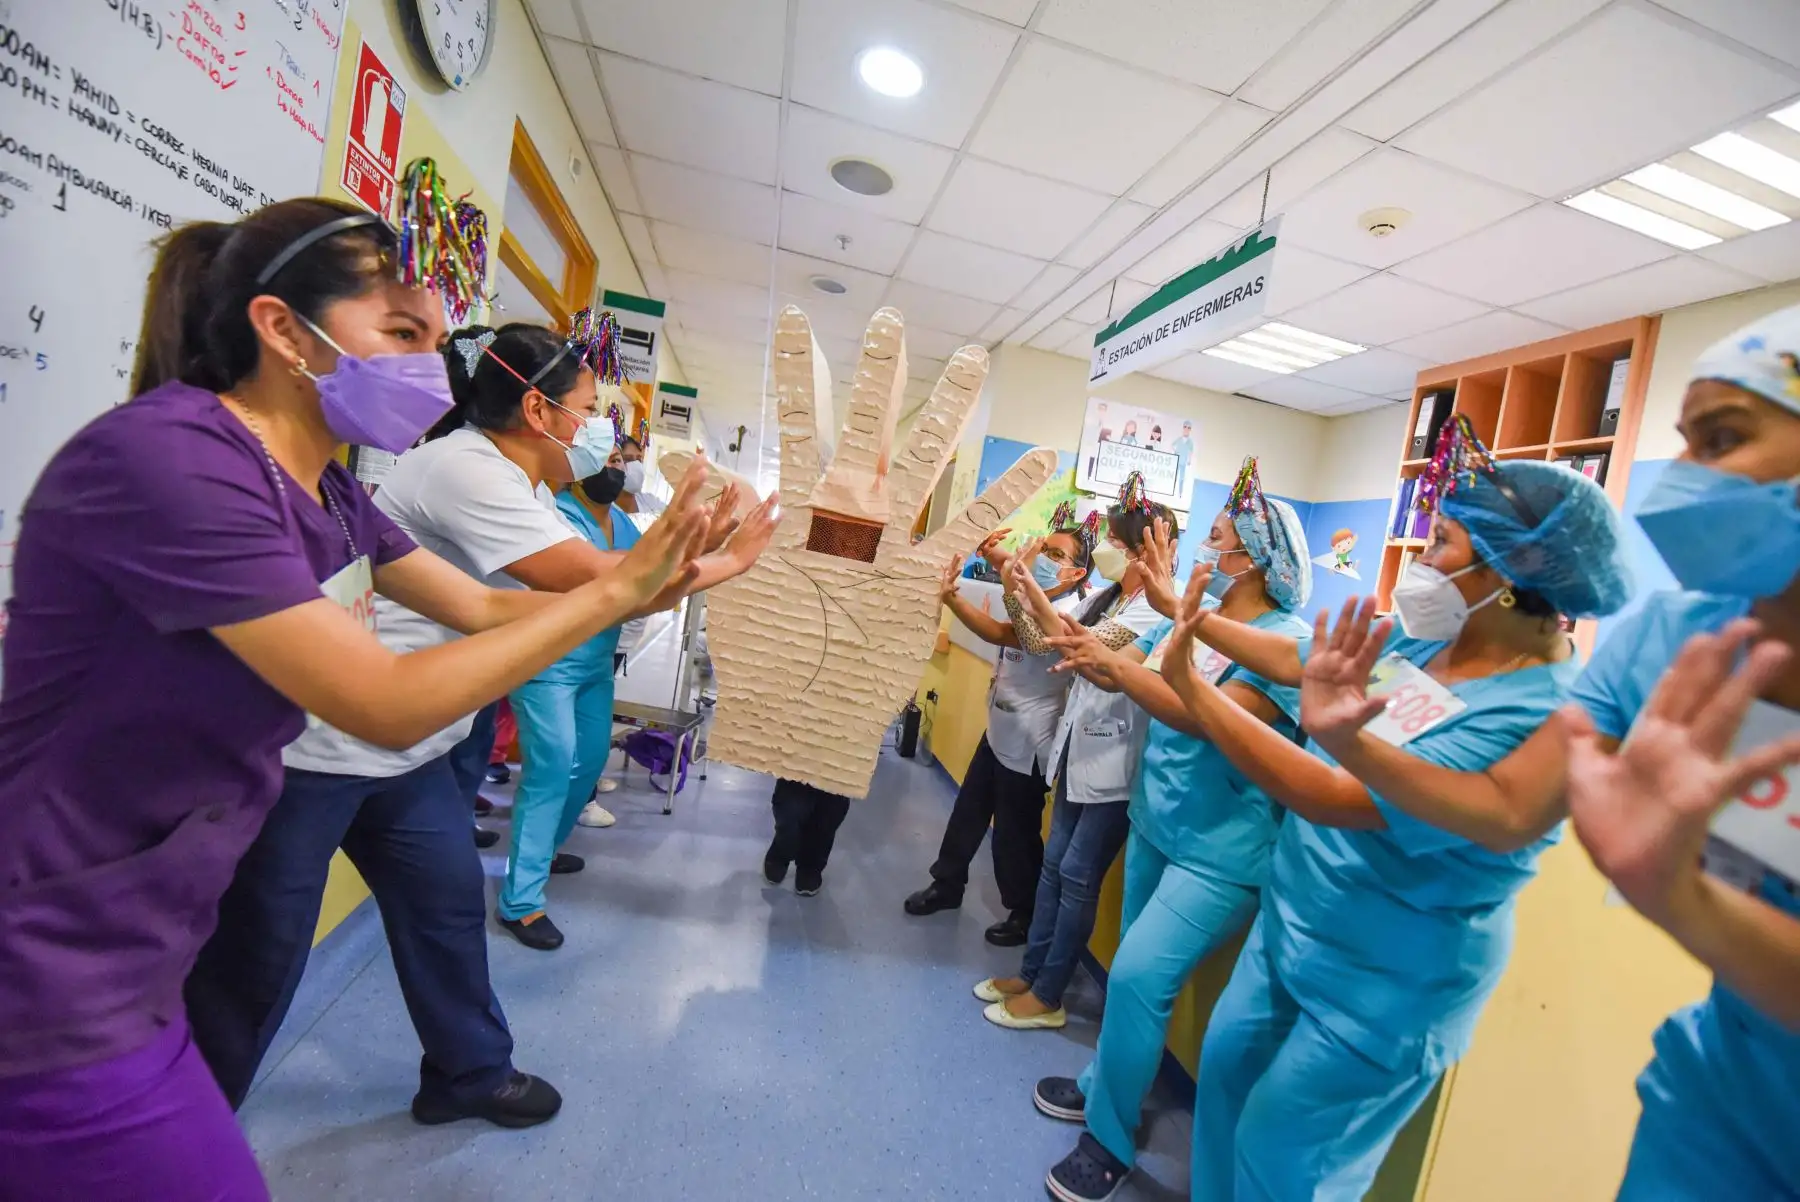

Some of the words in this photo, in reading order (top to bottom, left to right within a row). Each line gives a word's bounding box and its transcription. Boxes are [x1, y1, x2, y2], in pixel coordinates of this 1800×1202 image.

[234, 12, 246, 31] 3
[294, 12, 302, 30] 2
[313, 80, 320, 98] 1
[192, 148, 228, 182] HERNIA
[350, 147, 381, 184] EXTINTOR
[52, 181, 67, 212] 1
[194, 173, 218, 198] CABO
[28, 304, 45, 334] 4
[1108, 332, 1152, 366] ESTACIÓN
[1155, 323, 1170, 342] DE
[1172, 275, 1264, 334] ENFERMERAS
[36, 352, 48, 371] 5
[1105, 444, 1172, 466] SEGUNDOS
[1100, 456, 1125, 470] QUE
[1129, 462, 1174, 480] SALVAN
